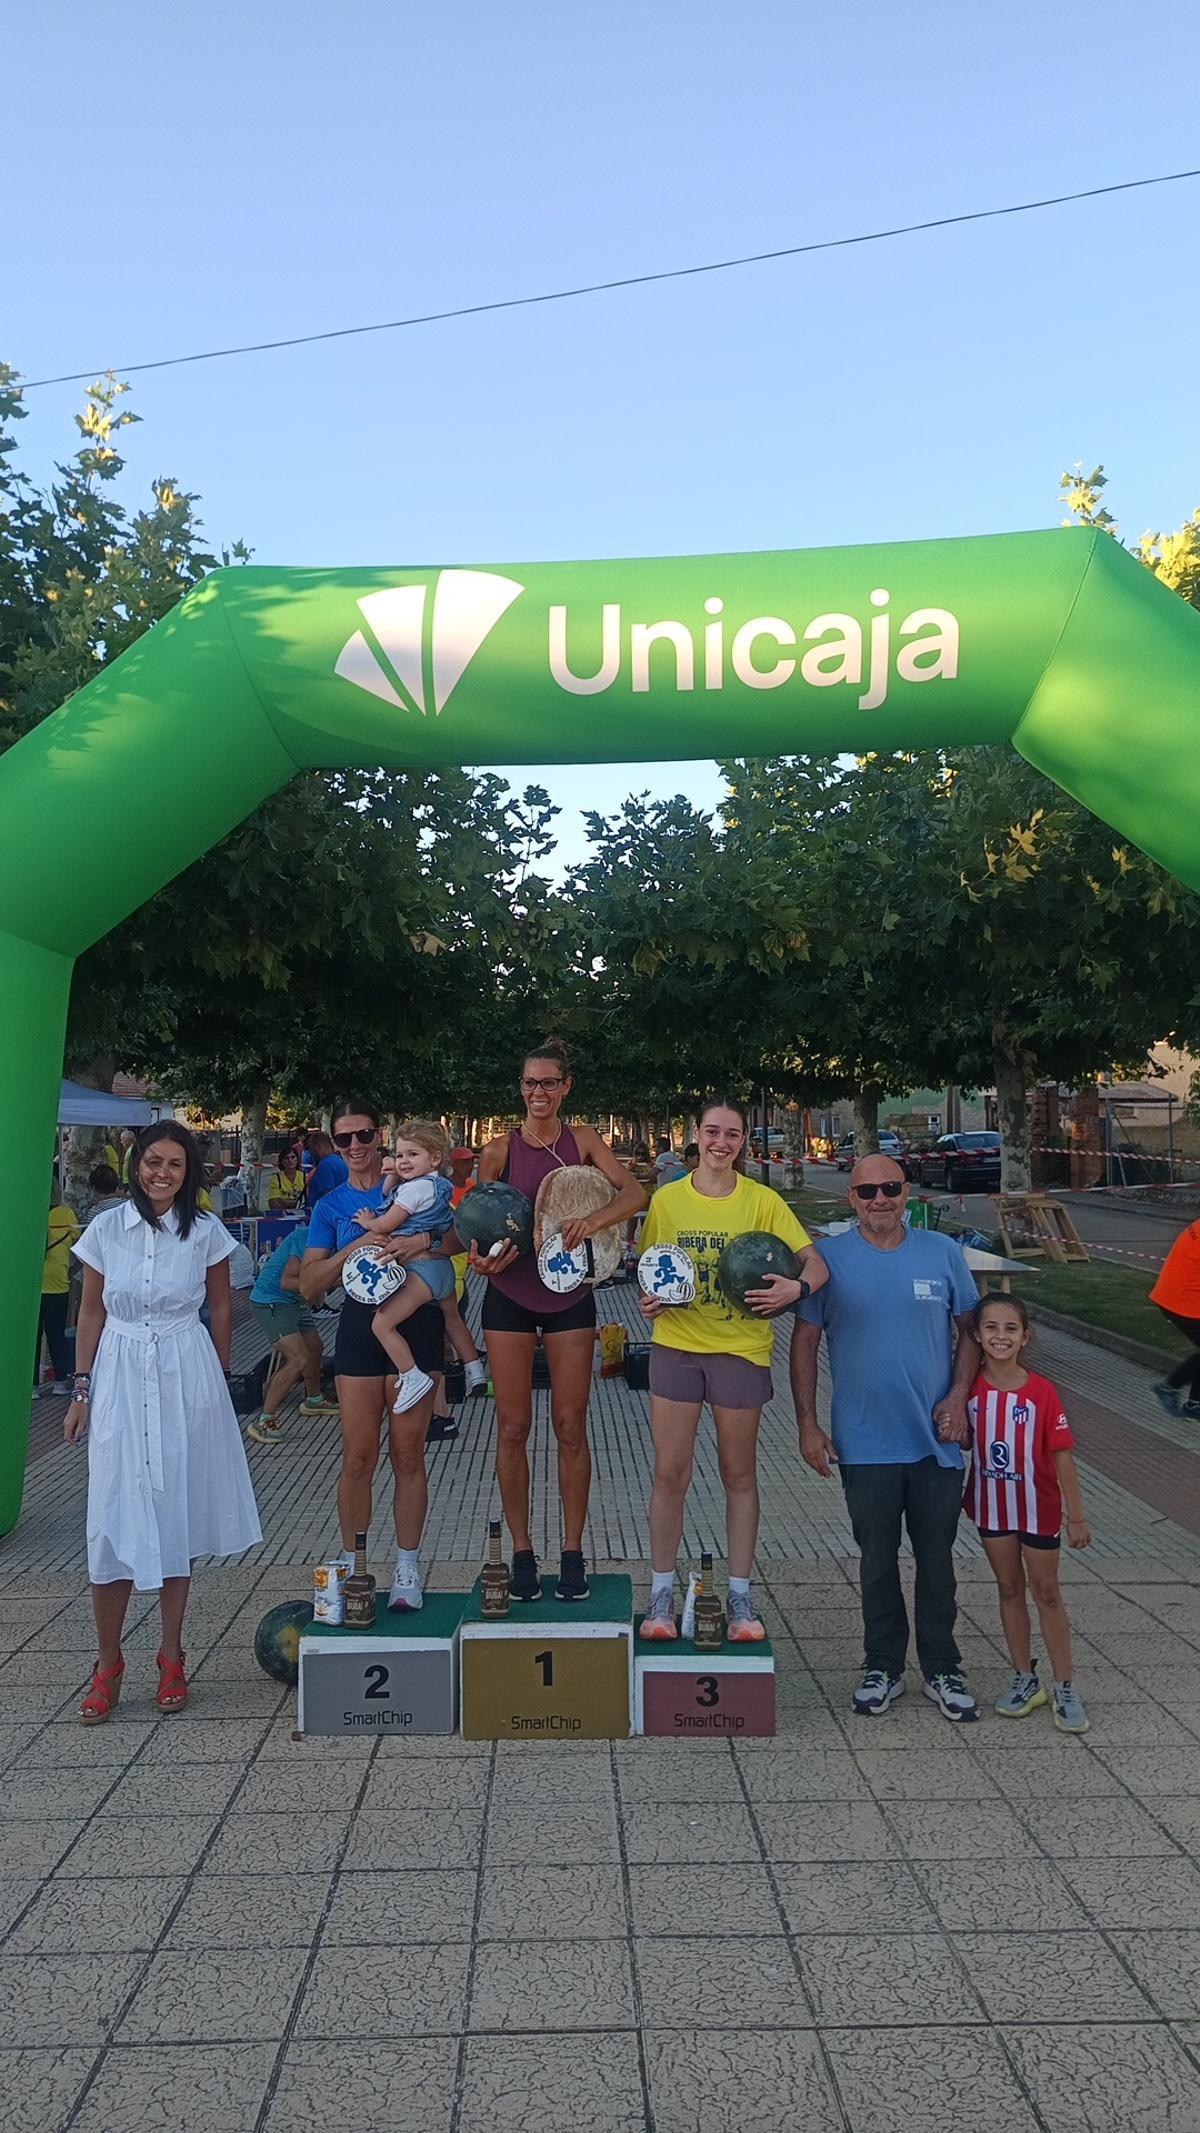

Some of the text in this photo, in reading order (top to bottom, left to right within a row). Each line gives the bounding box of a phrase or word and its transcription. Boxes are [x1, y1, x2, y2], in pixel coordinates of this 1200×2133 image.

[549, 588, 959, 711] Unicaja
[678, 1237, 725, 1249] RIBERA DEL
[535, 1651, 553, 1686] 1
[364, 1665, 390, 1699] 2
[696, 1676, 720, 1707] 3
[343, 1711, 412, 1726] SmartChip
[511, 1715, 581, 1731] SmartChip
[674, 1713, 745, 1730] SmartChip
